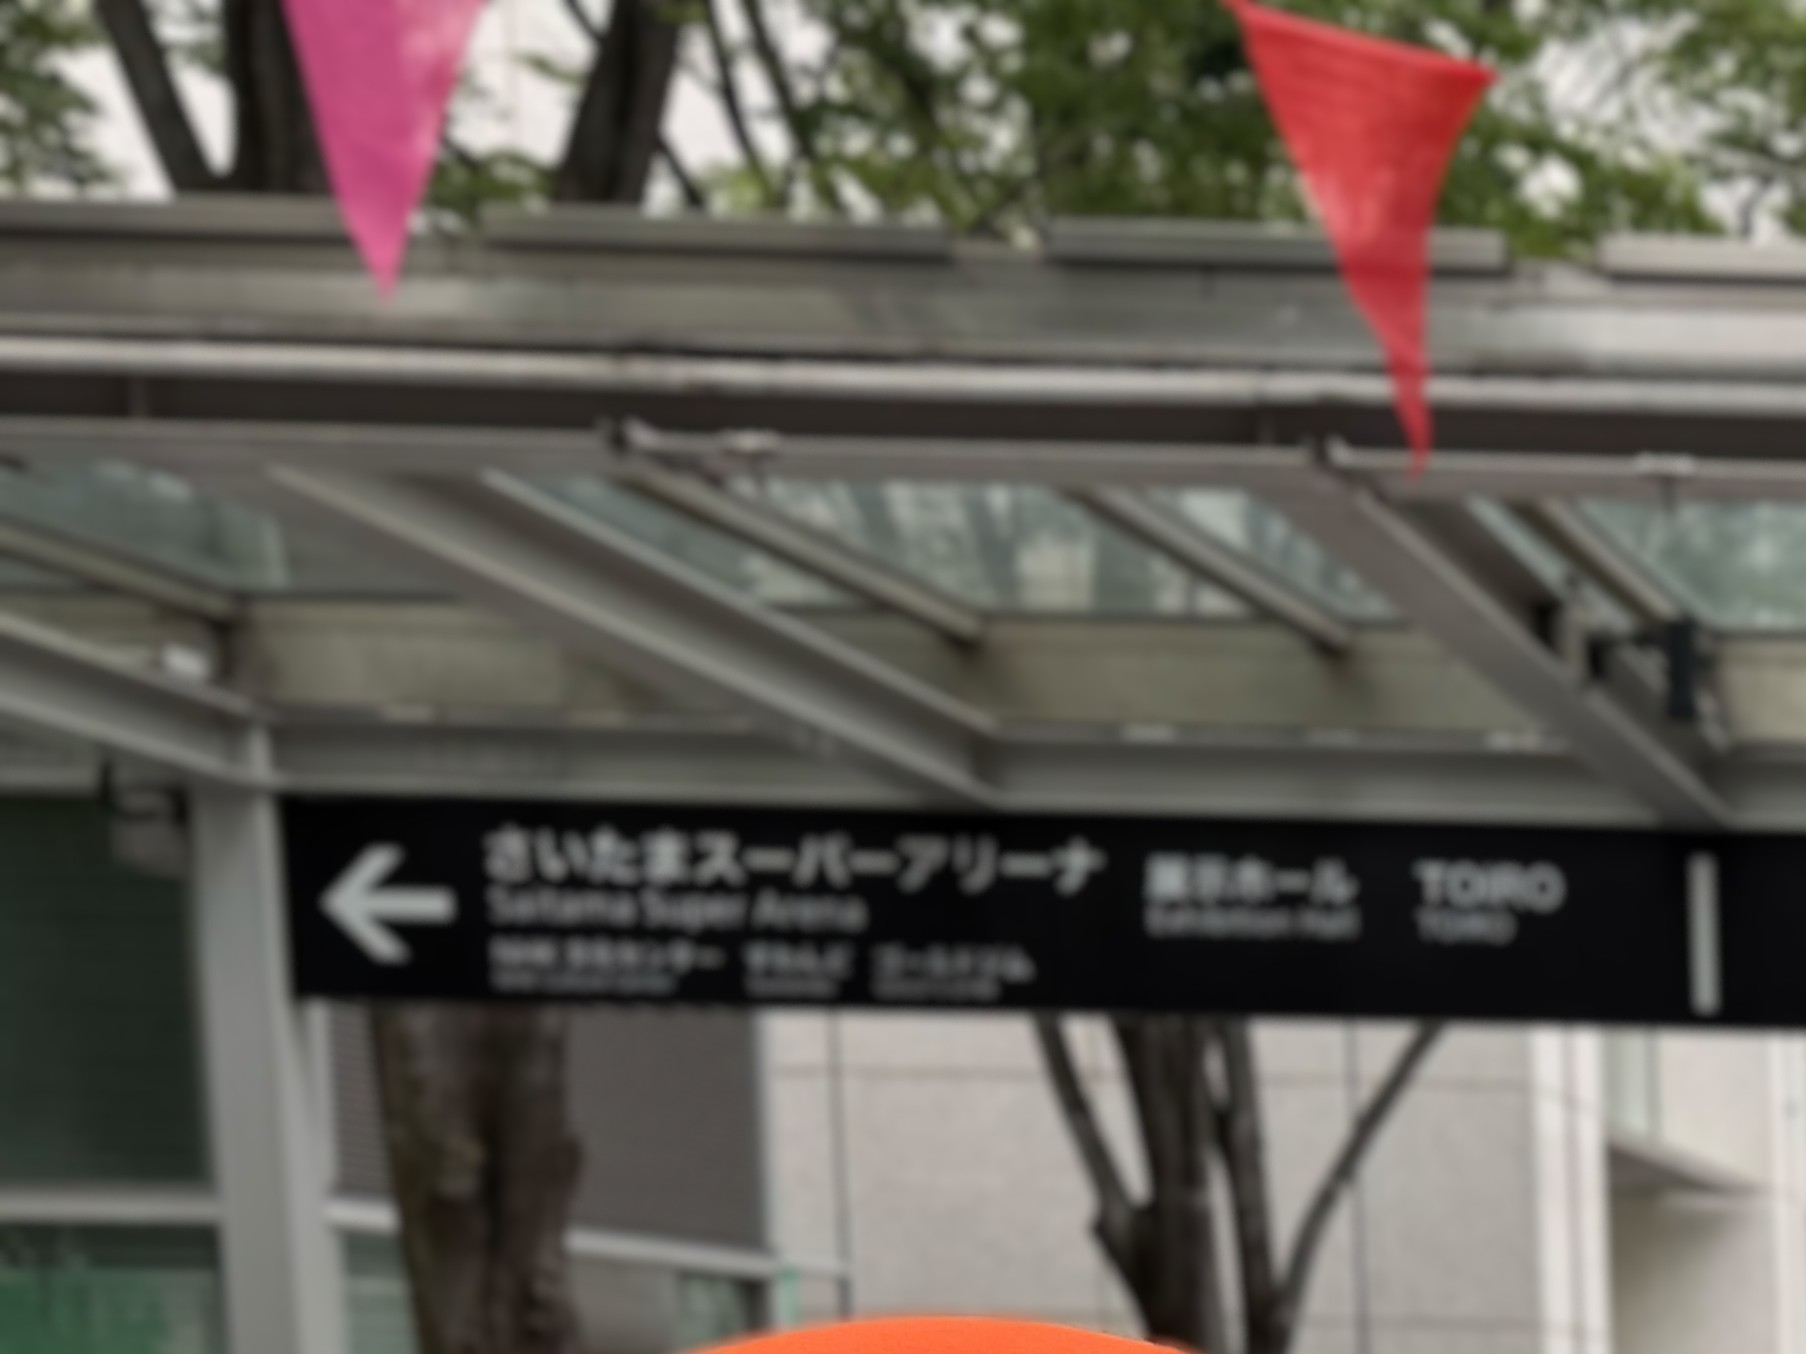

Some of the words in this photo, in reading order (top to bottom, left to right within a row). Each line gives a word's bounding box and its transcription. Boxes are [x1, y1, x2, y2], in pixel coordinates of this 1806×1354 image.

[485, 825, 1105, 892] さいたまスーパーアリーナ
